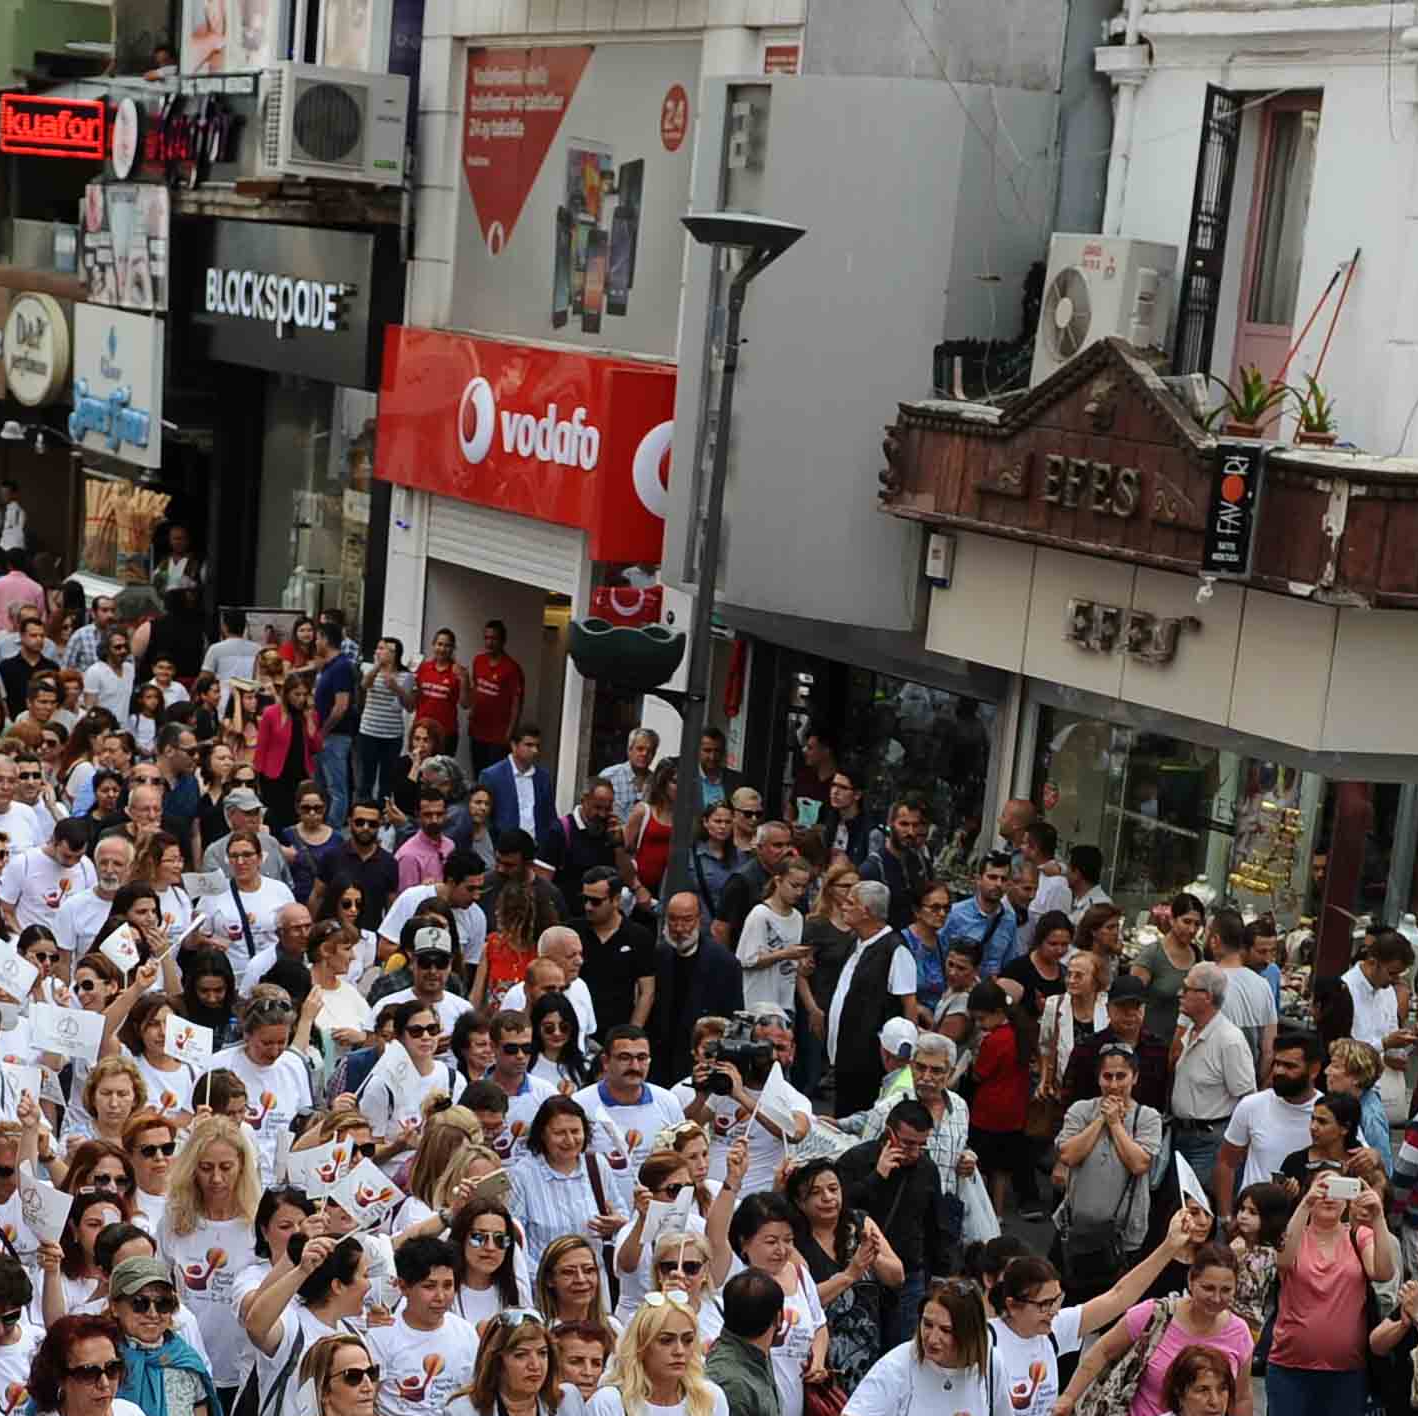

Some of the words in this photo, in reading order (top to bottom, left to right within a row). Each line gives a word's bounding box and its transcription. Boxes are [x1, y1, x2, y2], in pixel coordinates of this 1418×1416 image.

[501, 403, 600, 471] vodafo
[1045, 453, 1142, 517] EFES
[1064, 597, 1202, 664] EFES
